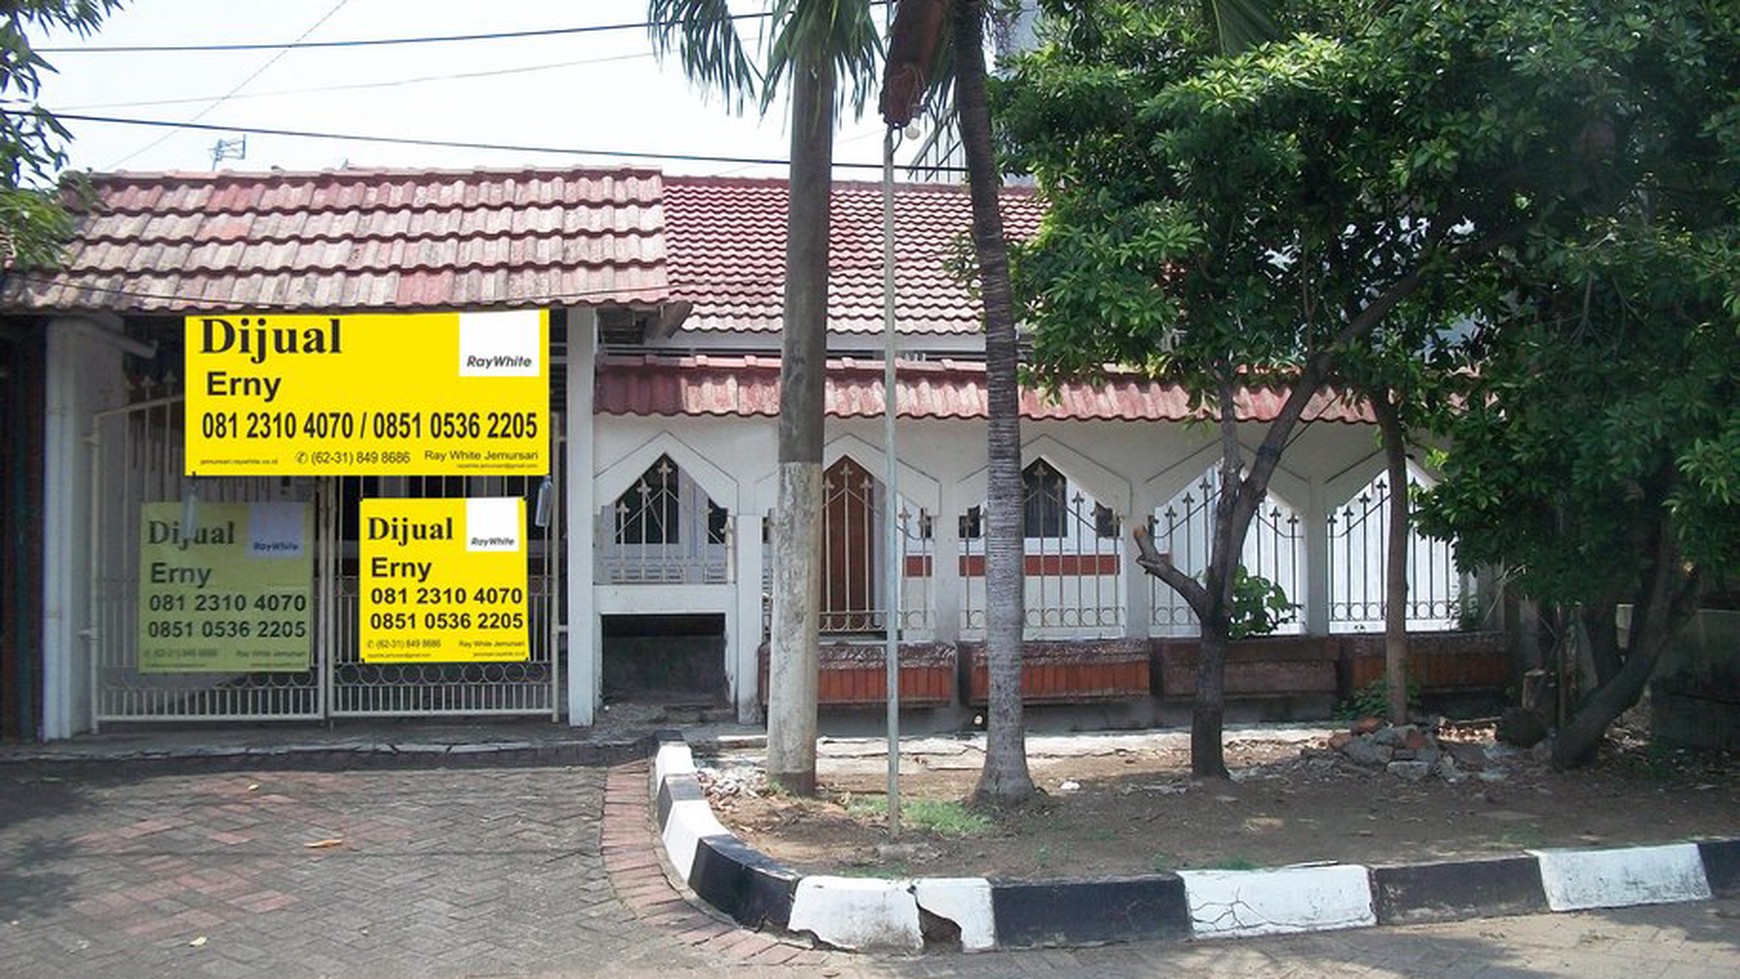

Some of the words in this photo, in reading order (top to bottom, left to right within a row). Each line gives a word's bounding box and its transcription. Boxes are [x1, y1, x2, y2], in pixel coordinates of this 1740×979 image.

[200, 318, 342, 364] Dijual
[466, 355, 532, 369] RayWhite
[206, 371, 281, 402] Erny
[202, 411, 238, 439] 081
[246, 411, 297, 439] 2310
[303, 411, 354, 439] 4070
[359, 411, 367, 439] /
[373, 411, 422, 439] 0851
[430, 411, 480, 439] 0536
[487, 411, 538, 439] 2205
[311, 451, 355, 466] (62-31)
[356, 451, 379, 464] 849
[380, 451, 411, 464] 8686
[424, 450, 447, 462] Ray
[449, 450, 482, 460] White
[484, 450, 538, 460] Jemursari
[367, 516, 454, 546] Dijual
[151, 562, 212, 589] Erny
[371, 556, 432, 583] Erny
[149, 594, 185, 612] 081
[194, 594, 246, 612] 2310
[253, 594, 307, 612] 4070
[370, 587, 407, 605] 081
[416, 587, 467, 605] 2310
[473, 587, 523, 605] 4070
[148, 621, 193, 638] 0851
[201, 621, 251, 638] 0536
[257, 621, 307, 638] 2205
[370, 612, 416, 630] 0851
[424, 612, 471, 630] 0536
[477, 612, 524, 630] 2205
